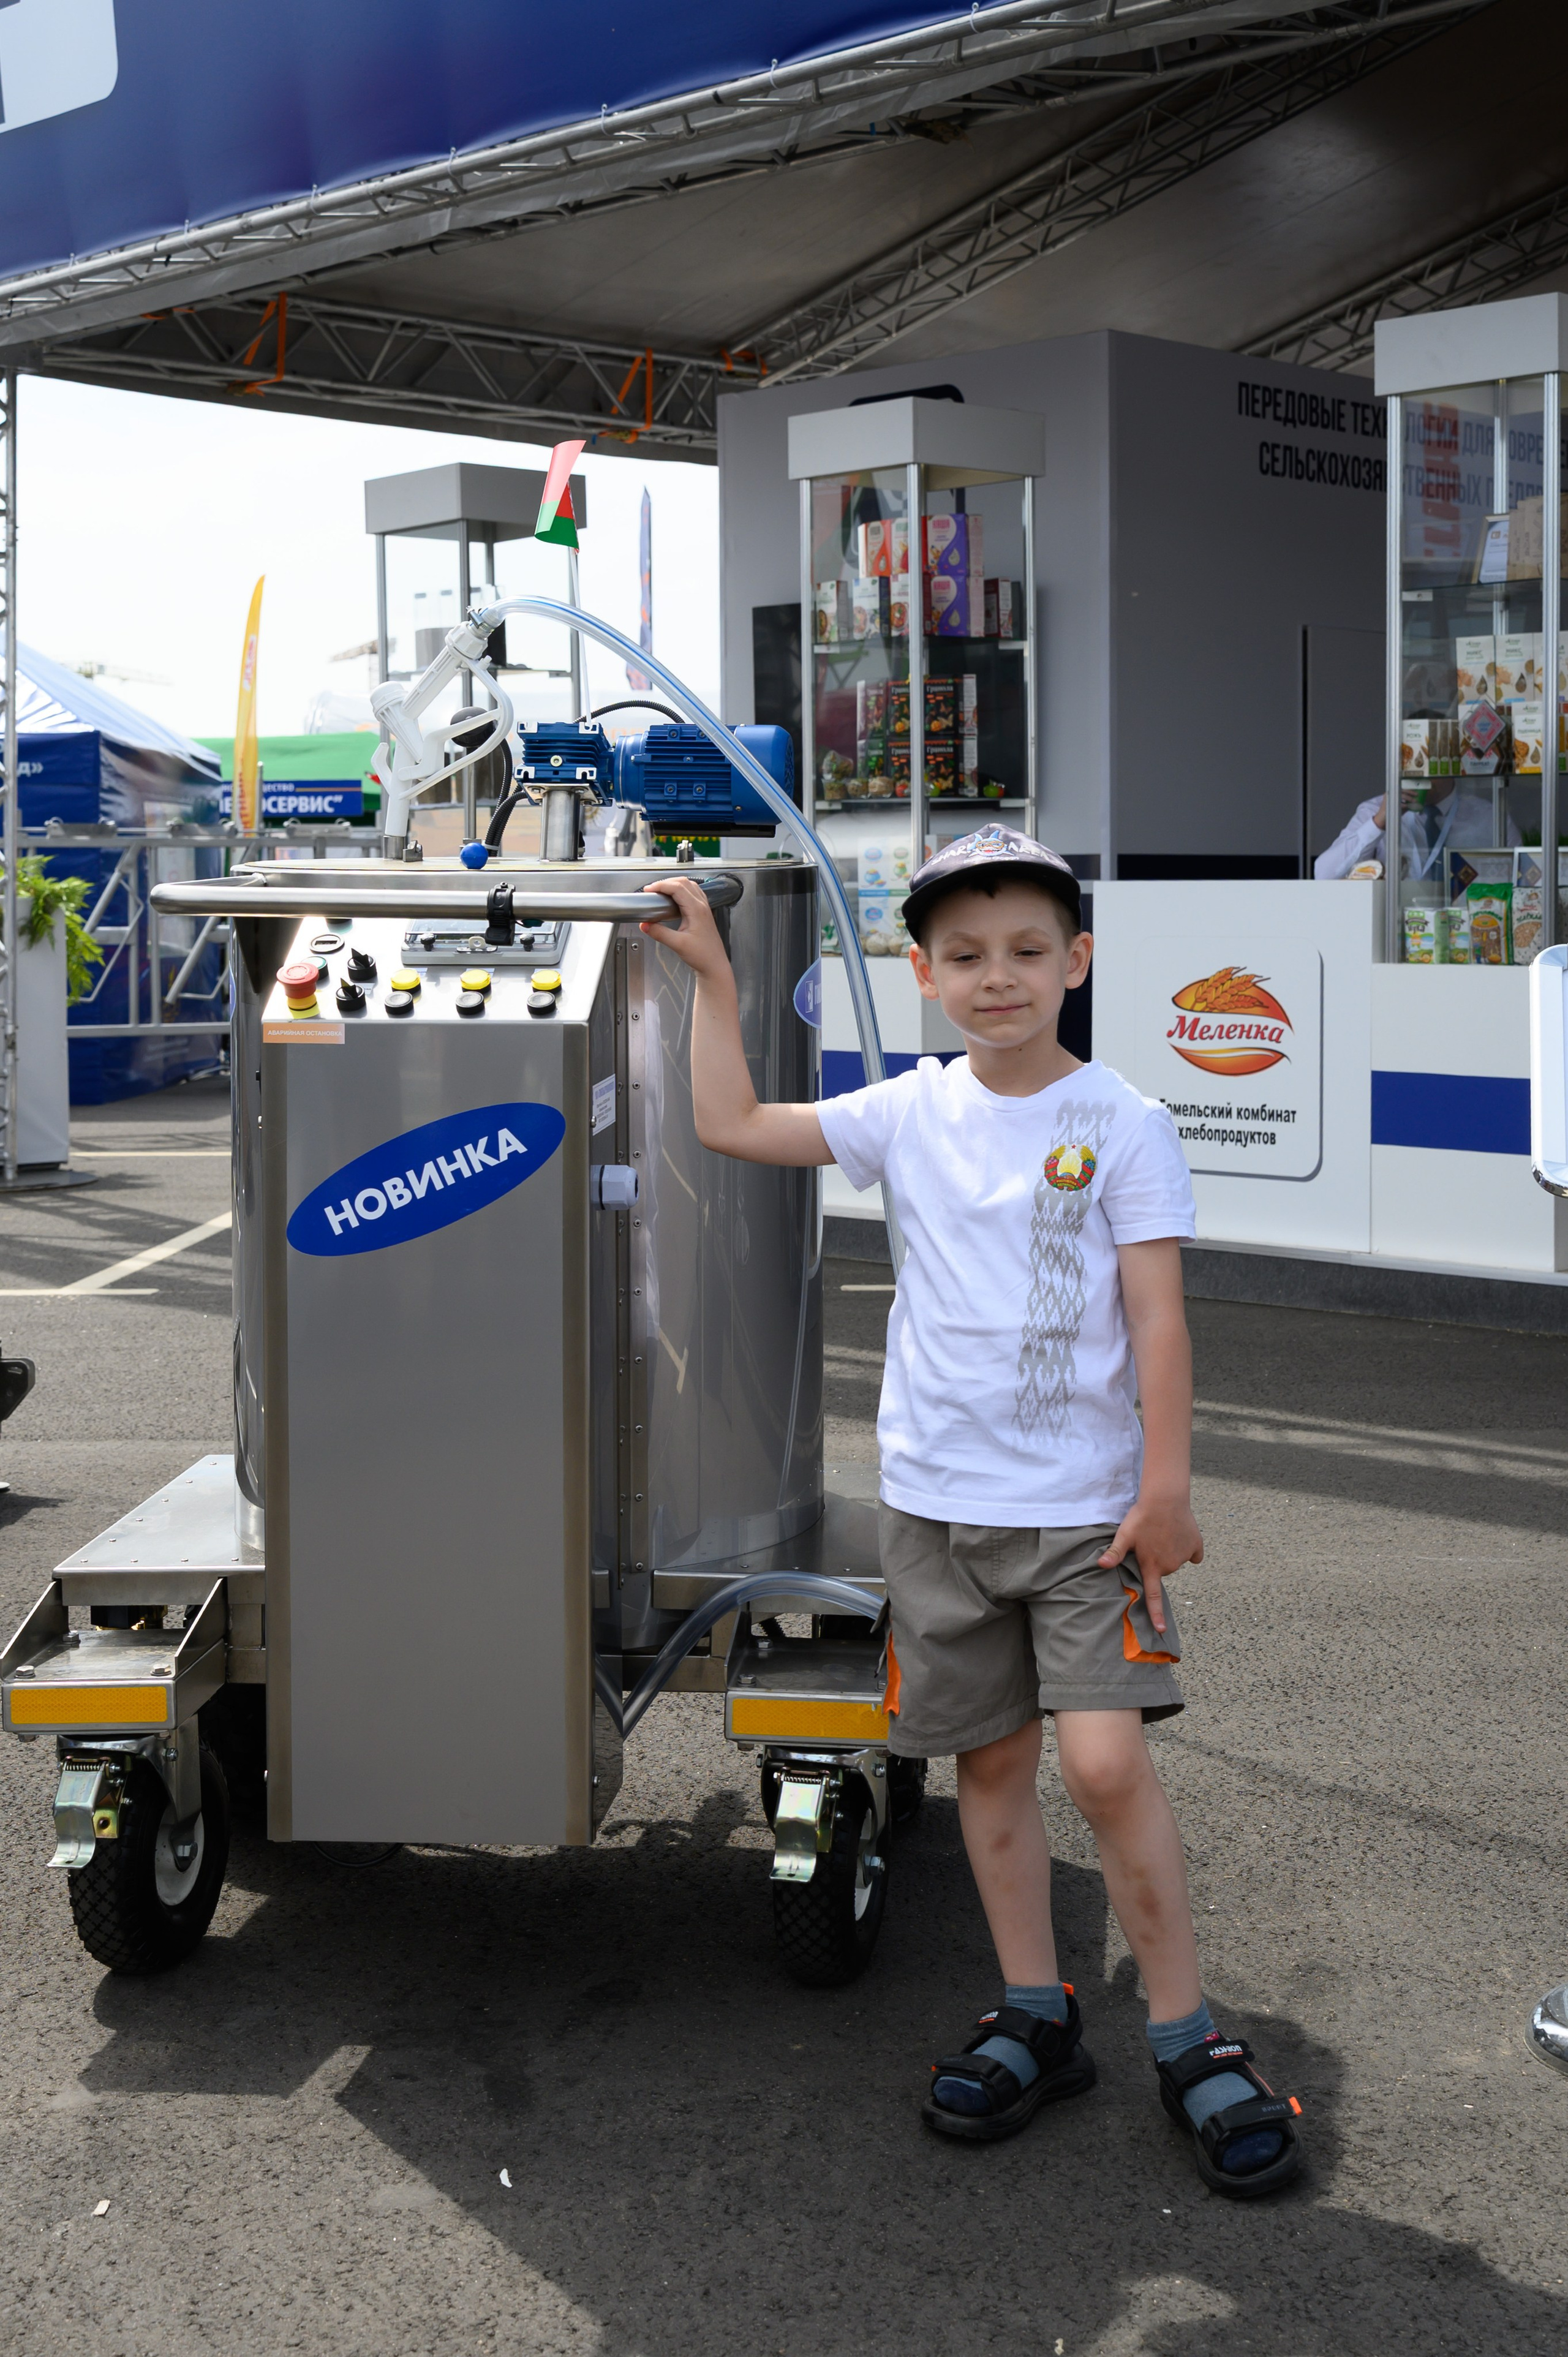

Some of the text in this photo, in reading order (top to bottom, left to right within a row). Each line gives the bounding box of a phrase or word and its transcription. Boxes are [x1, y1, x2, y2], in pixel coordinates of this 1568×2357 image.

[1238, 381, 1346, 433] ПЕРЕДОВЫЕ
[1351, 401, 1460, 451] ТЕХЛОГИИ
[1166, 1014, 1285, 1044] Меленка
[1236, 1104, 1297, 1123] комбинат
[1178, 1123, 1276, 1148] хлебопродуктов
[323, 1126, 528, 1235] НОВИНКА
